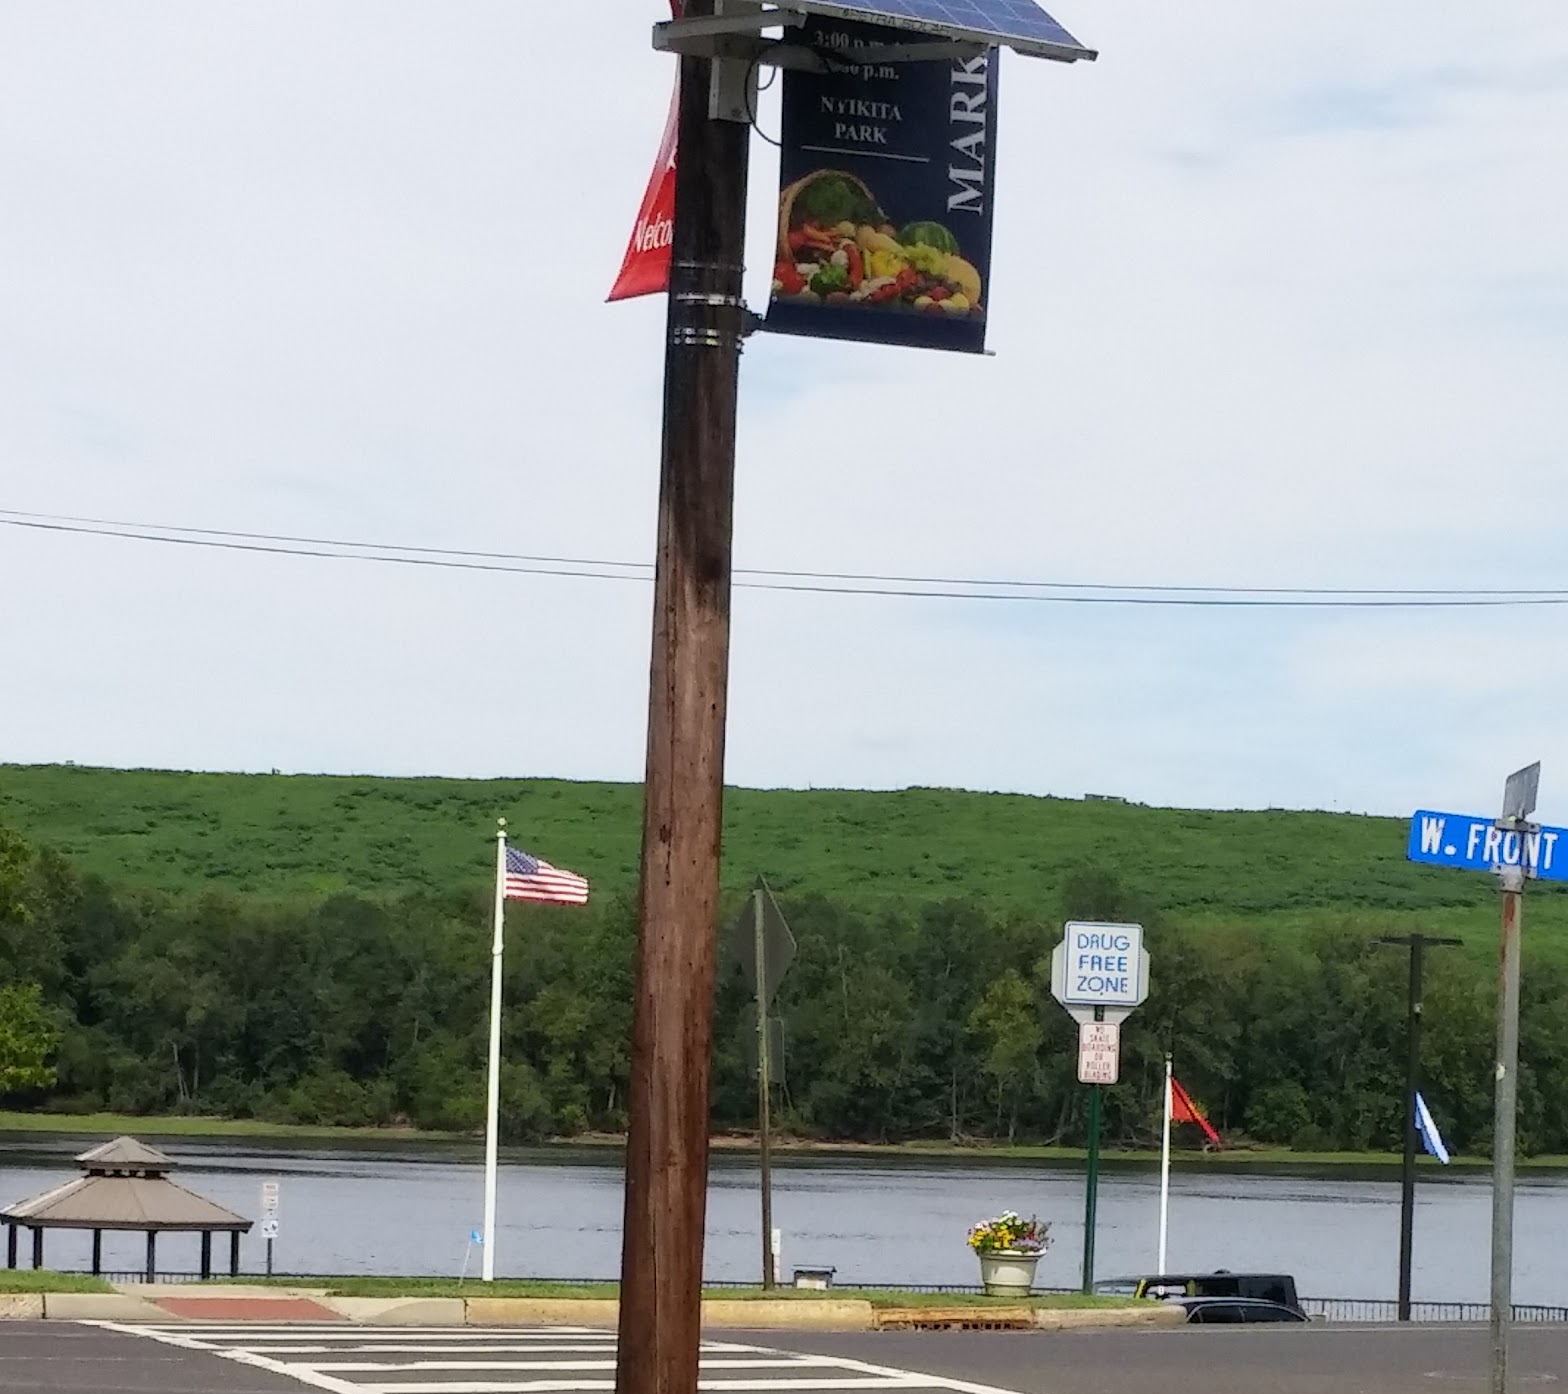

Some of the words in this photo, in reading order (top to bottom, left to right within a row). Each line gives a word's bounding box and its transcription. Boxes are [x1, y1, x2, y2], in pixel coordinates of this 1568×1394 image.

[862, 64, 900, 81] p.m.
[834, 121, 887, 145] PARK
[947, 53, 988, 216] MARK
[1421, 816, 1457, 855] W.
[1466, 823, 1559, 870] FRONT
[1077, 933, 1130, 951] DRUG
[1078, 954, 1128, 972] FREE
[1077, 975, 1128, 993] ZONE
